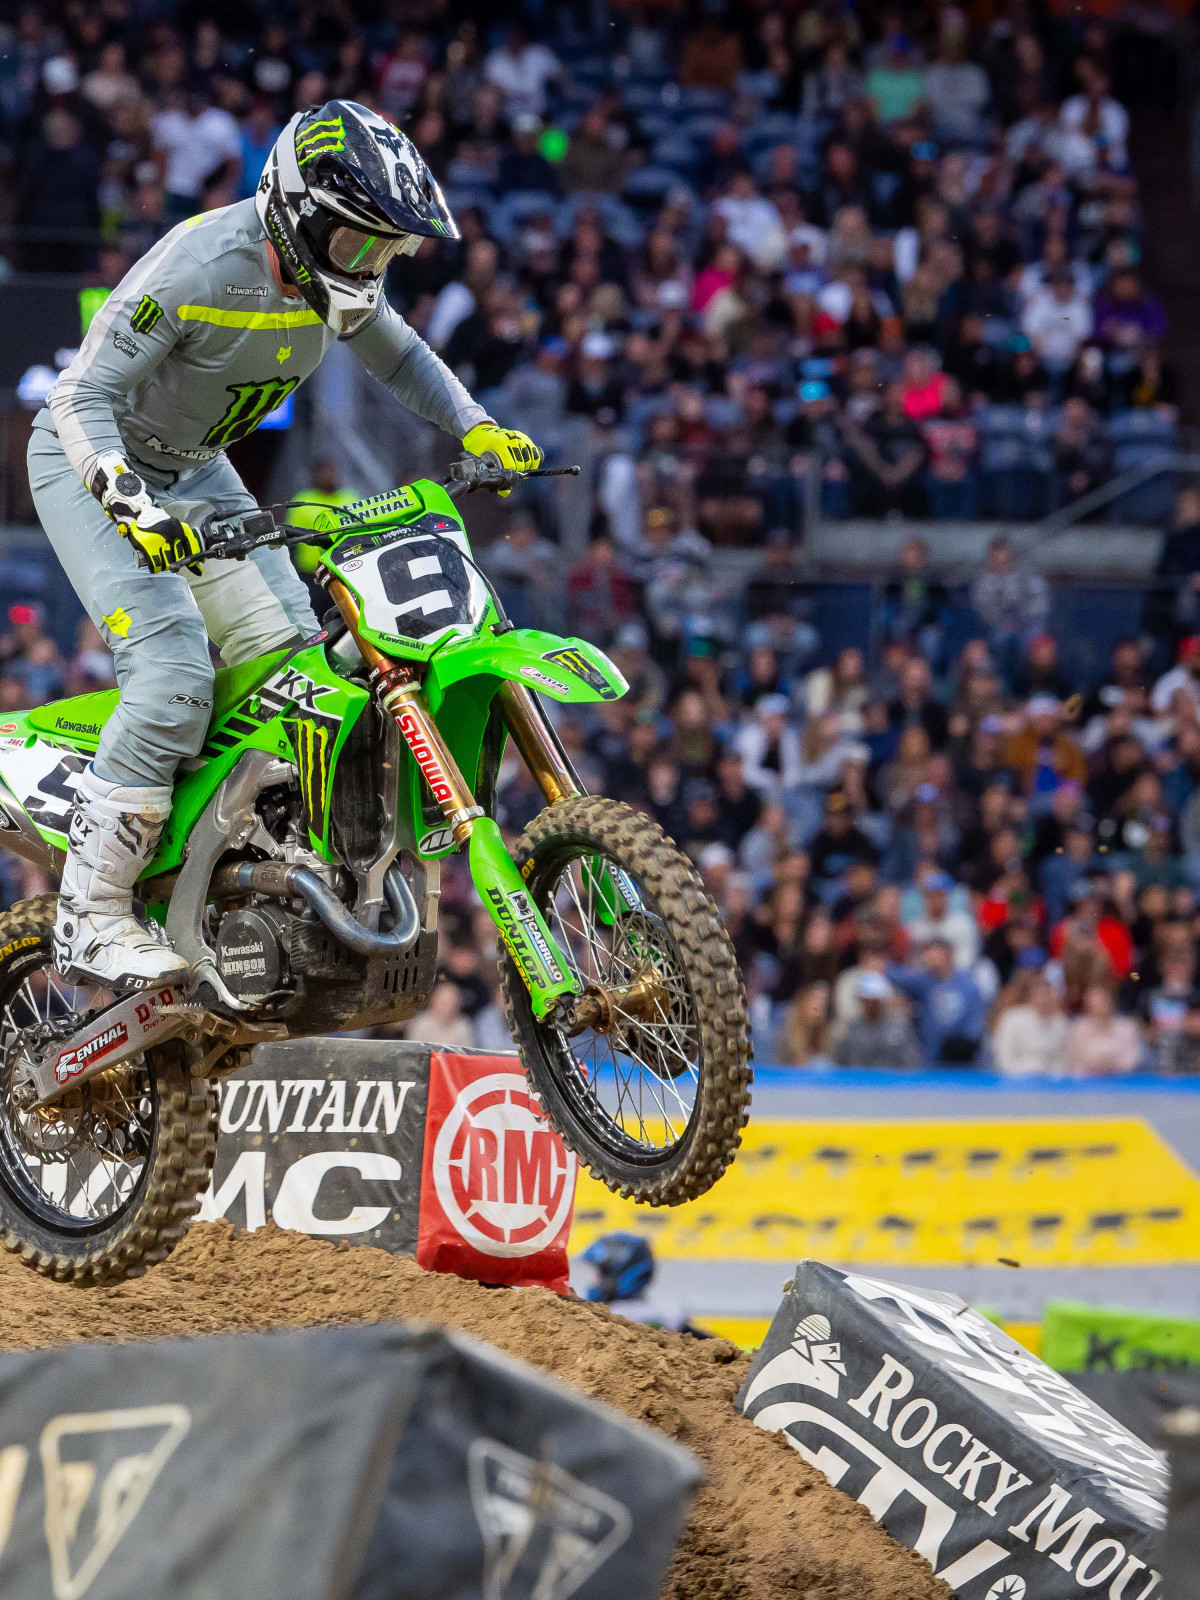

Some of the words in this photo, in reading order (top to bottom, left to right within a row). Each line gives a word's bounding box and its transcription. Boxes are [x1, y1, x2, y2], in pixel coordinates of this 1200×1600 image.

[226, 285, 268, 297] Kawasaki
[377, 538, 473, 639] 9
[378, 632, 425, 651] Kawasaki
[274, 667, 336, 709] KX
[55, 716, 102, 736] Kawasaki
[396, 712, 455, 804] SHOWA
[74, 813, 94, 838] OX
[221, 941, 264, 957] Kawasaki
[486, 886, 546, 989] DUNLOP
[125, 977, 154, 989] FOX
[56, 1025, 126, 1082] RENTHAL
[217, 1079, 415, 1135] UNTAIN
[470, 1129, 559, 1204] RM
[847, 1353, 1033, 1517] ROCKY
